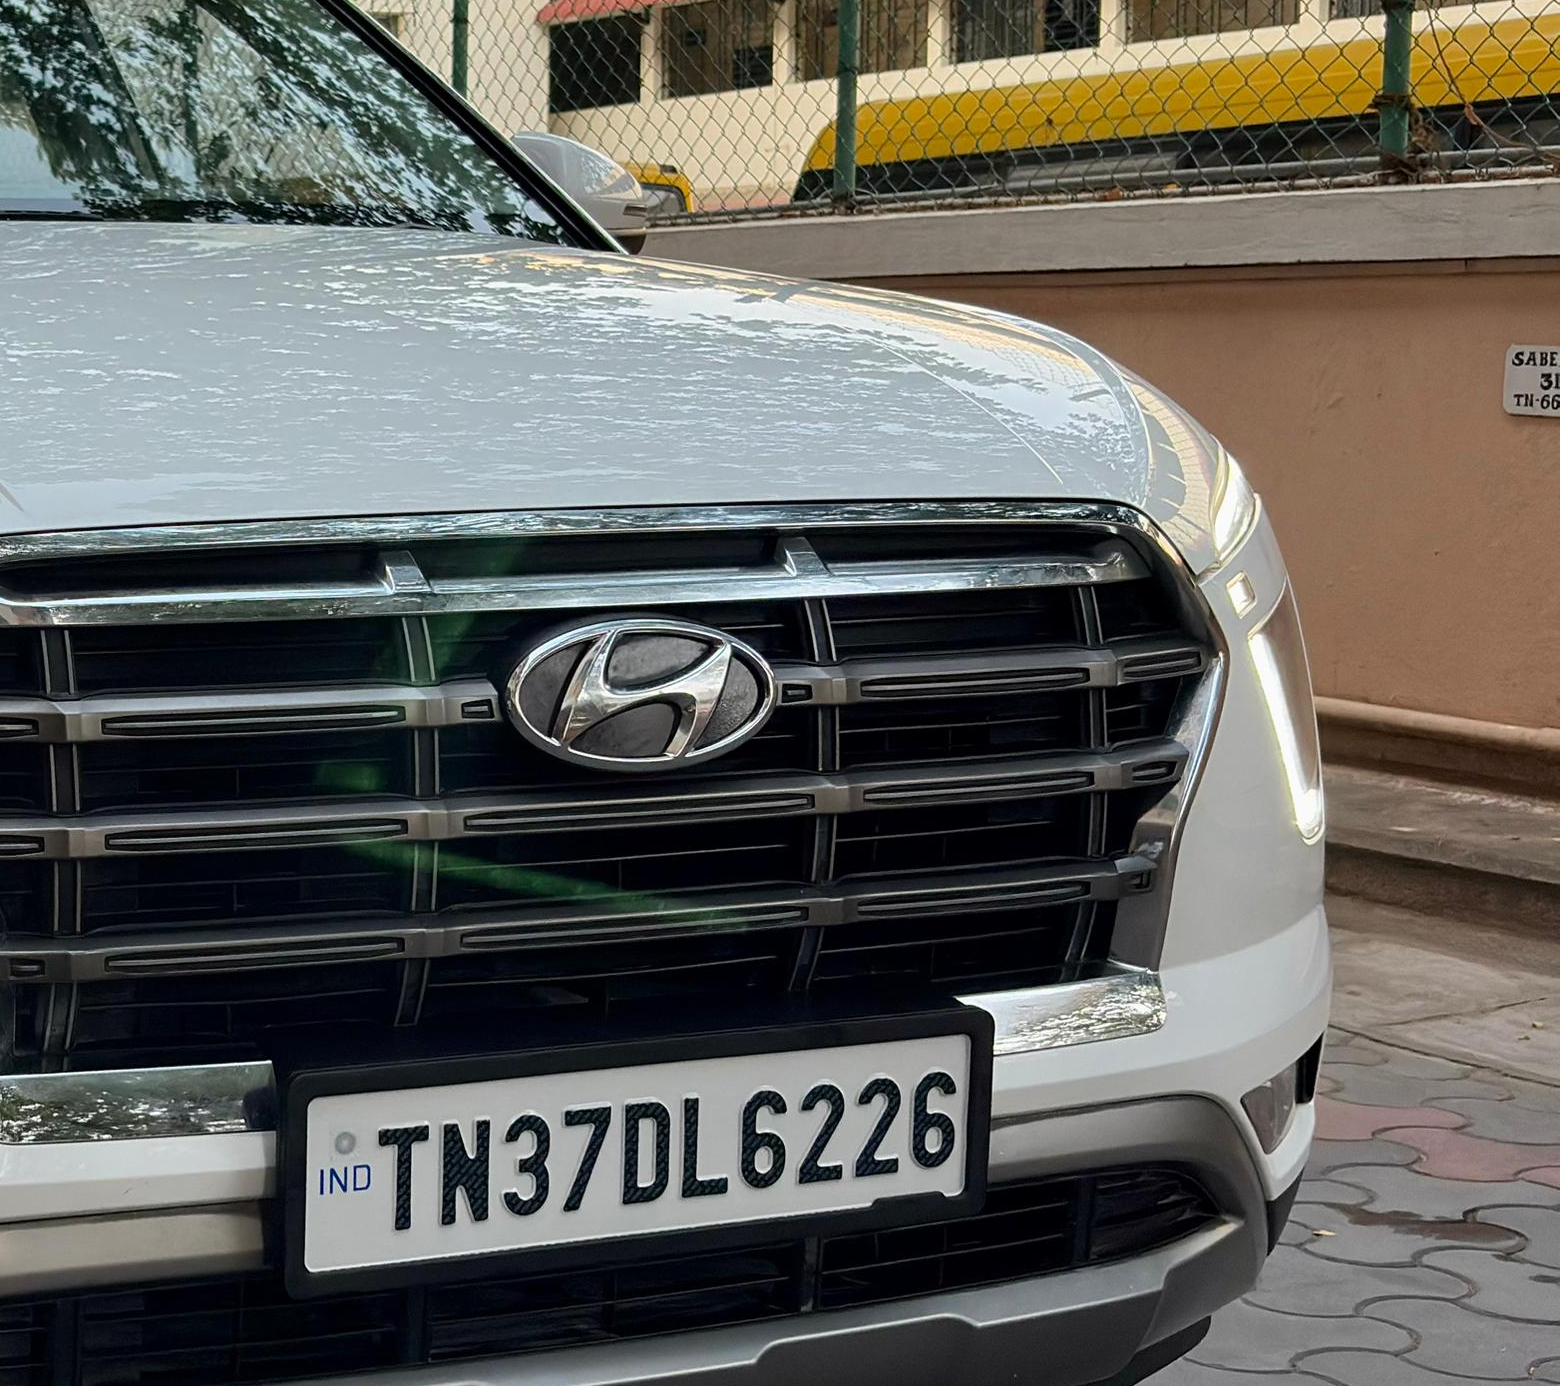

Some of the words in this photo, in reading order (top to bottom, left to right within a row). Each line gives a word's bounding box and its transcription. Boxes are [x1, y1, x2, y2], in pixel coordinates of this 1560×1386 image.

[1511, 351, 1560, 367] SABE
[377, 1069, 958, 1231] TN37DL6226
[319, 1164, 372, 1196] IND
